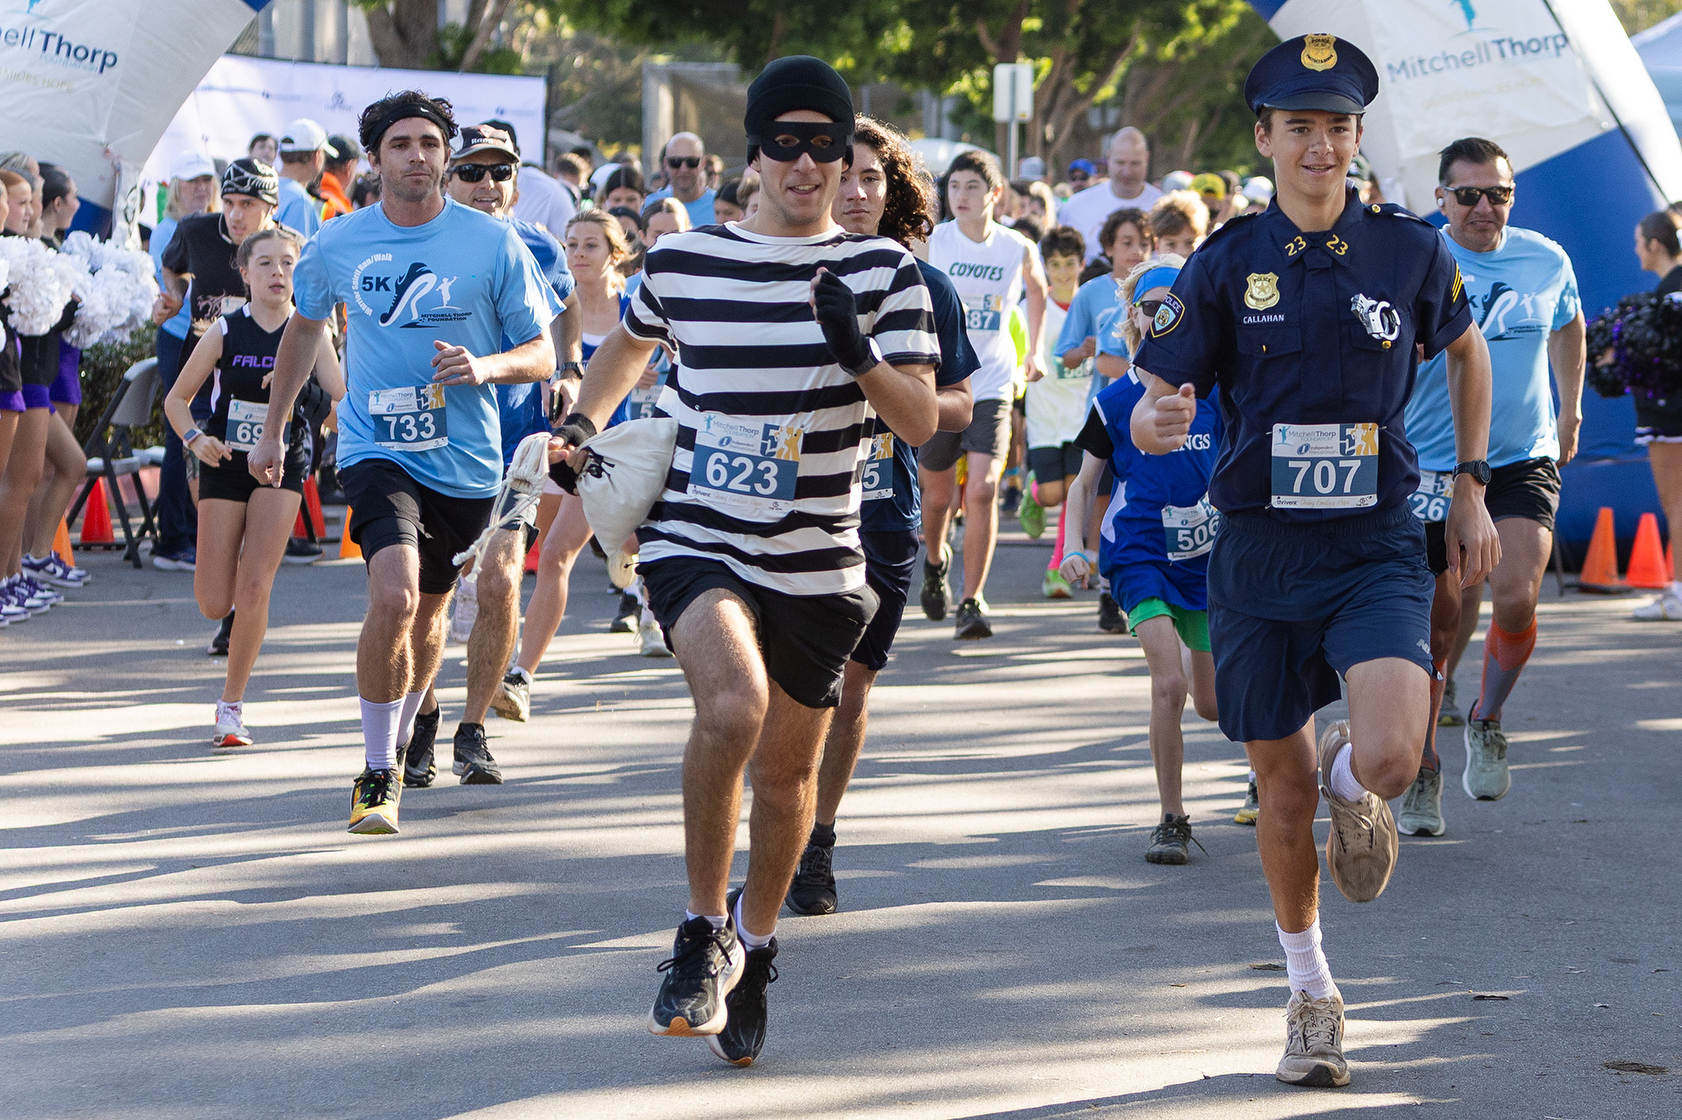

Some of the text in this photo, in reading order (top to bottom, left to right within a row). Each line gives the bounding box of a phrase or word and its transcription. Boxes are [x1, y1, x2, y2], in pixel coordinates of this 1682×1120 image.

[0, 26, 118, 74] ell Thorp
[1386, 32, 1569, 83] Mitchell Thorp
[1284, 235, 1307, 257] 23
[1326, 234, 1349, 256] 23
[949, 262, 1004, 281] COYOTES
[361, 276, 391, 292] 5K
[966, 310, 993, 329] 87
[1243, 314, 1285, 324] CALLAHAN
[232, 354, 277, 368] FALC
[236, 422, 264, 443] 69
[383, 412, 436, 442] 733
[713, 420, 760, 436] Mitchell Thorp
[1288, 430, 1337, 439] Mitchell Thorp
[706, 452, 779, 495] 623
[863, 462, 880, 490] 5
[1288, 460, 1361, 494] 707
[691, 488, 711, 498] thrivent
[1411, 493, 1446, 521] 26
[1177, 514, 1220, 551] 506
